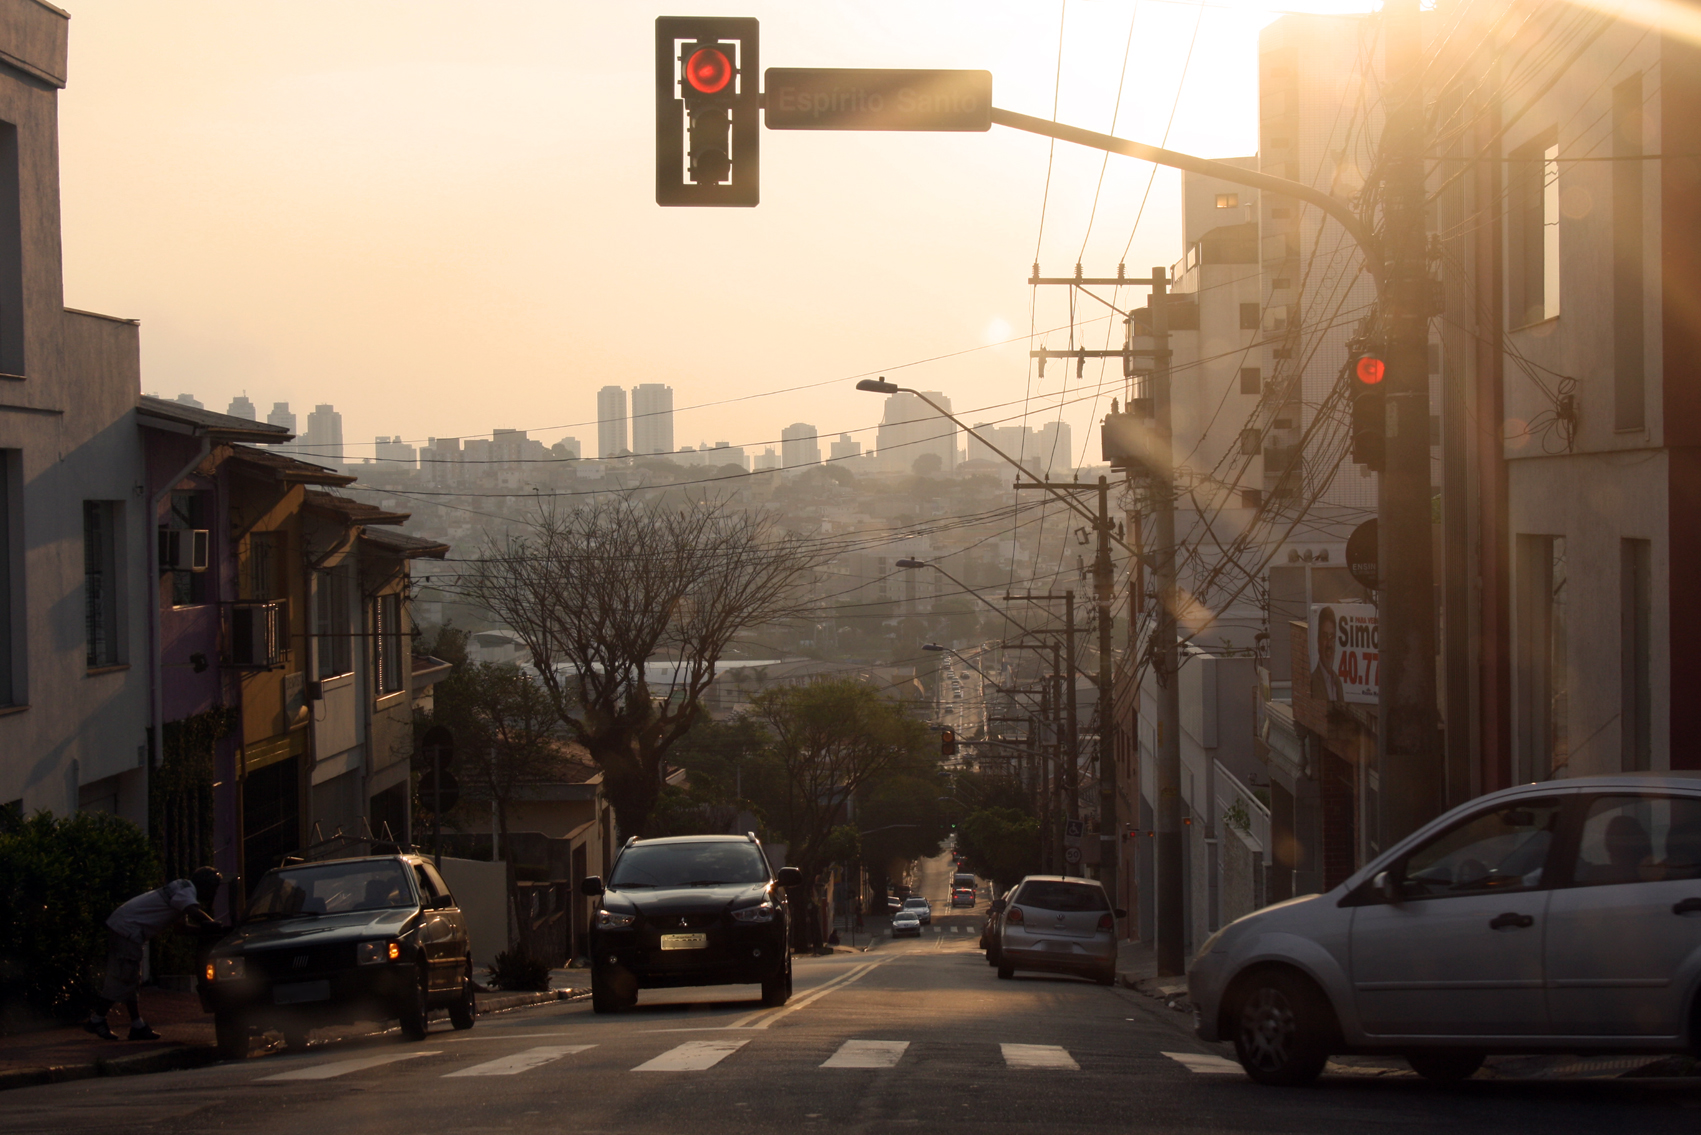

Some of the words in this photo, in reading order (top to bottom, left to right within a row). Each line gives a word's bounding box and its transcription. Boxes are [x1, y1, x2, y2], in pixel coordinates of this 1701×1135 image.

[779, 87, 883, 118] Espírito
[897, 87, 977, 113] Santo
[1067, 850, 1079, 858] 50
